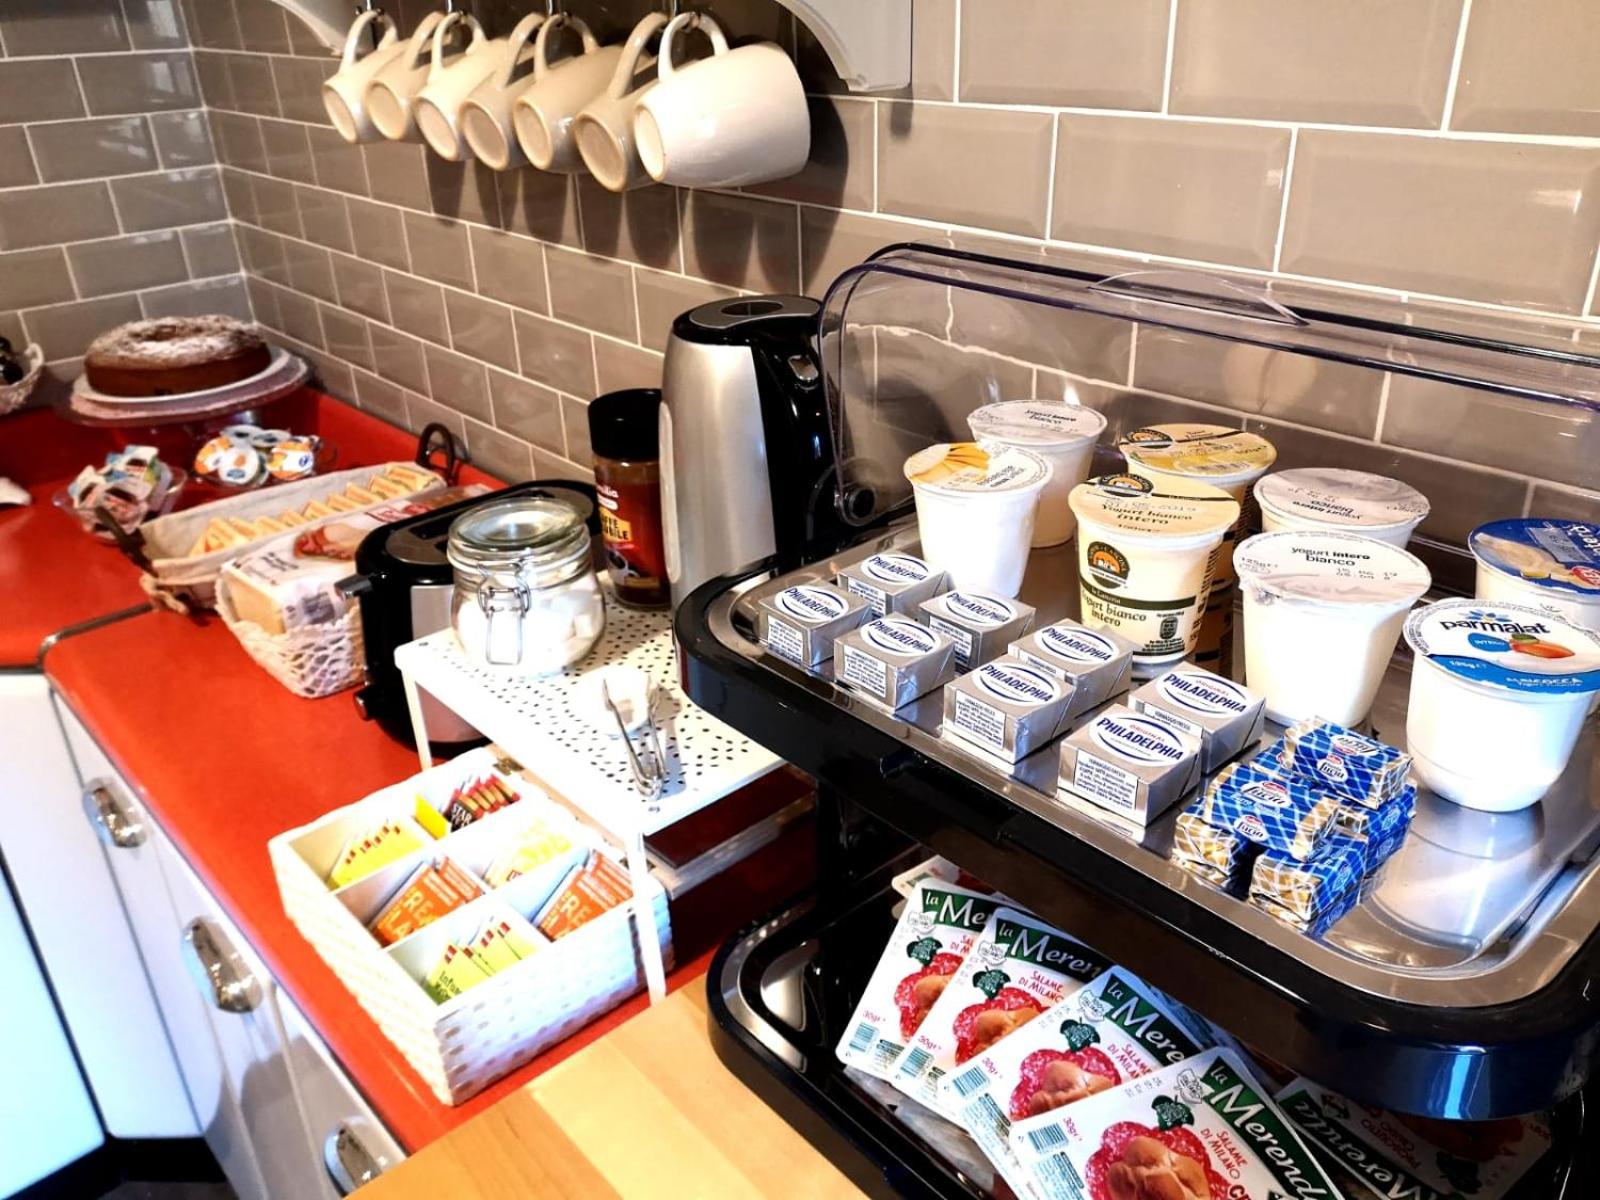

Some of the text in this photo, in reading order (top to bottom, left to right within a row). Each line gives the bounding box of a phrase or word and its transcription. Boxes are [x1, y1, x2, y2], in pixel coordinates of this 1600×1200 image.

[868, 556, 928, 582] PHILADELPHIA
[1291, 546, 1371, 561] yogurt intero
[1305, 554, 1356, 567] bianco
[784, 587, 841, 619] PHILADELPHIA
[946, 591, 1010, 624] PHILADELPHIA
[1091, 609, 1121, 627] intero
[1106, 603, 1147, 622] bianco
[868, 619, 934, 653] PHILADELPHIA
[1440, 618, 1552, 635] parmalat
[1041, 626, 1114, 663] PHILADELPHIA
[980, 664, 1054, 702] PHILADELPHIA
[1163, 673, 1248, 713] PHILADELPHIA
[1097, 717, 1184, 761] PHILADELPHIA
[926, 891, 990, 928] la Me
[999, 922, 1103, 978] la Meren
[1018, 976, 1028, 988] DI
[1030, 970, 1065, 994] SALAME
[1107, 981, 1124, 1000] la
[1110, 996, 1186, 1065] Mere
[1106, 1043, 1142, 1080] DI MILA
[1122, 1043, 1153, 1076] SALAM
[1209, 1065, 1330, 1200] la Merend
[1216, 1130, 1248, 1168] SALAME
[1200, 1127, 1241, 1180] DI MILANO
